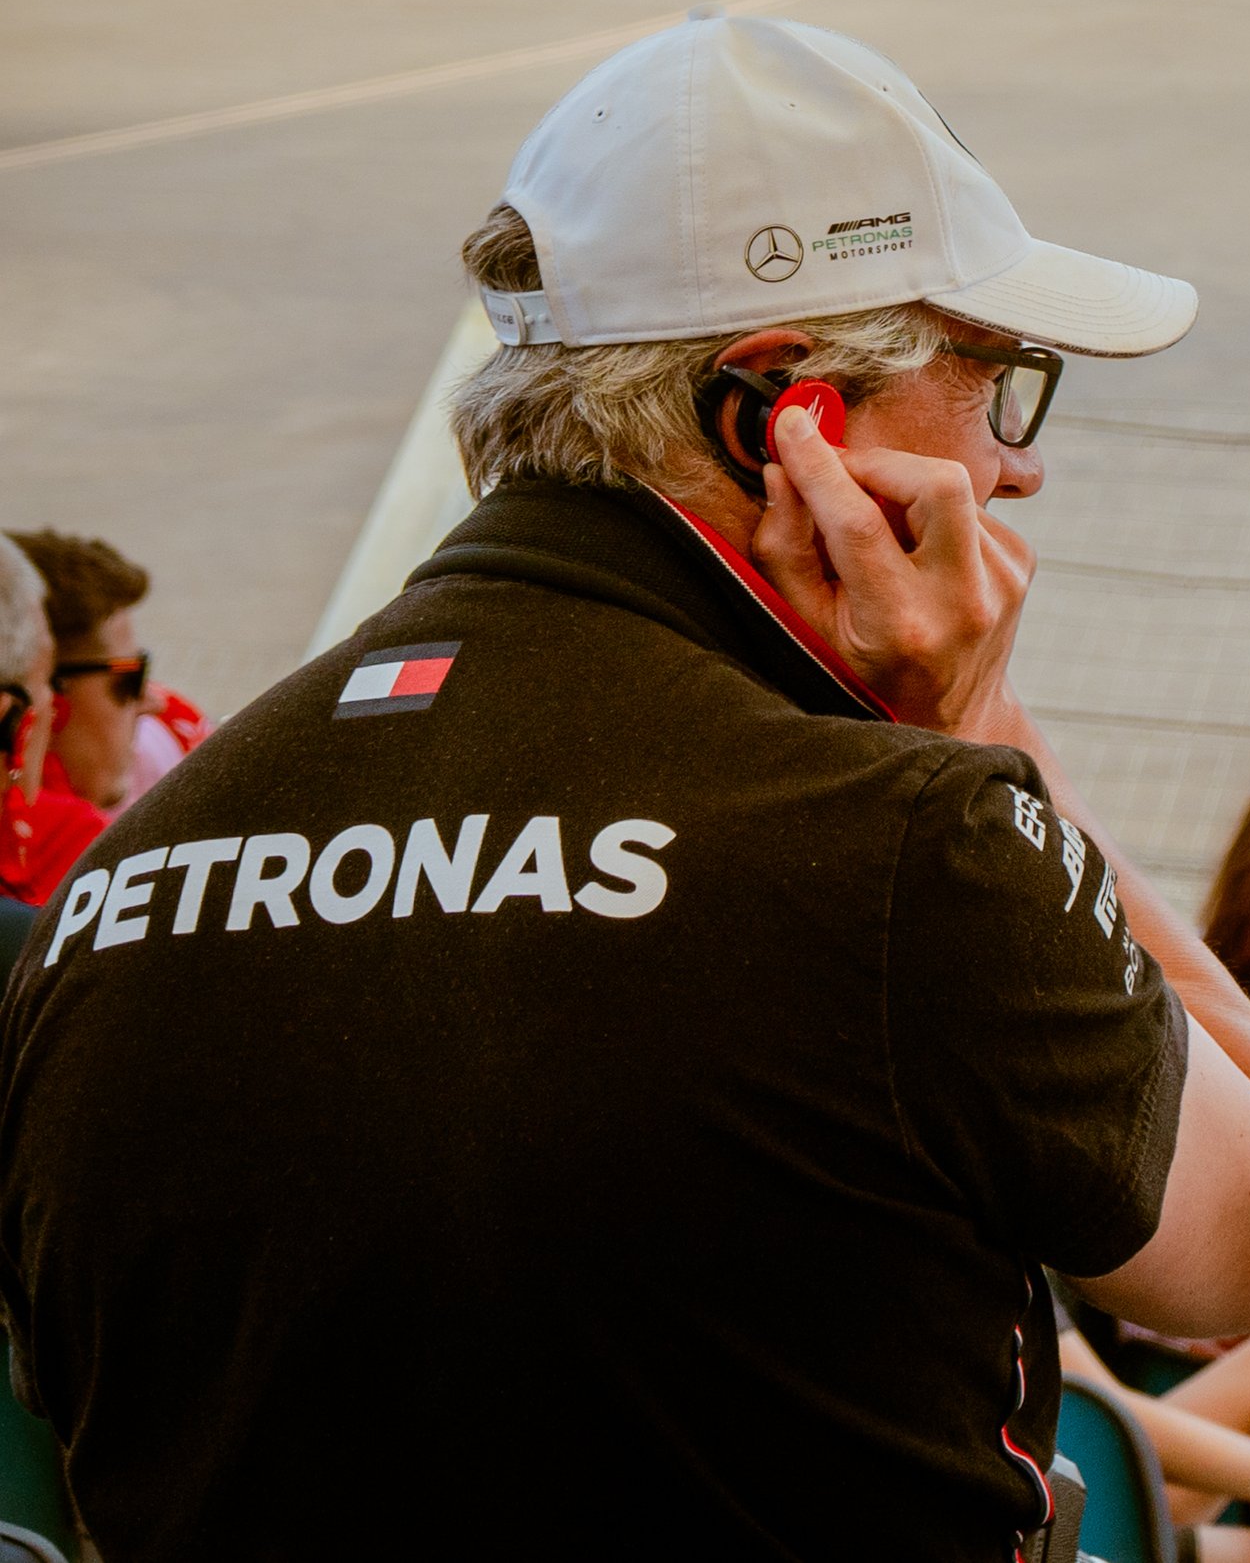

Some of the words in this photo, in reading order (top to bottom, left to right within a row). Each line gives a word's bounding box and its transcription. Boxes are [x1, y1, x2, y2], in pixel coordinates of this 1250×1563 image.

[853, 212, 911, 230] AMG
[812, 226, 913, 252] PETRONAS
[829, 240, 913, 261] MOTORSPORT
[43, 814, 676, 968] PETRONAS
